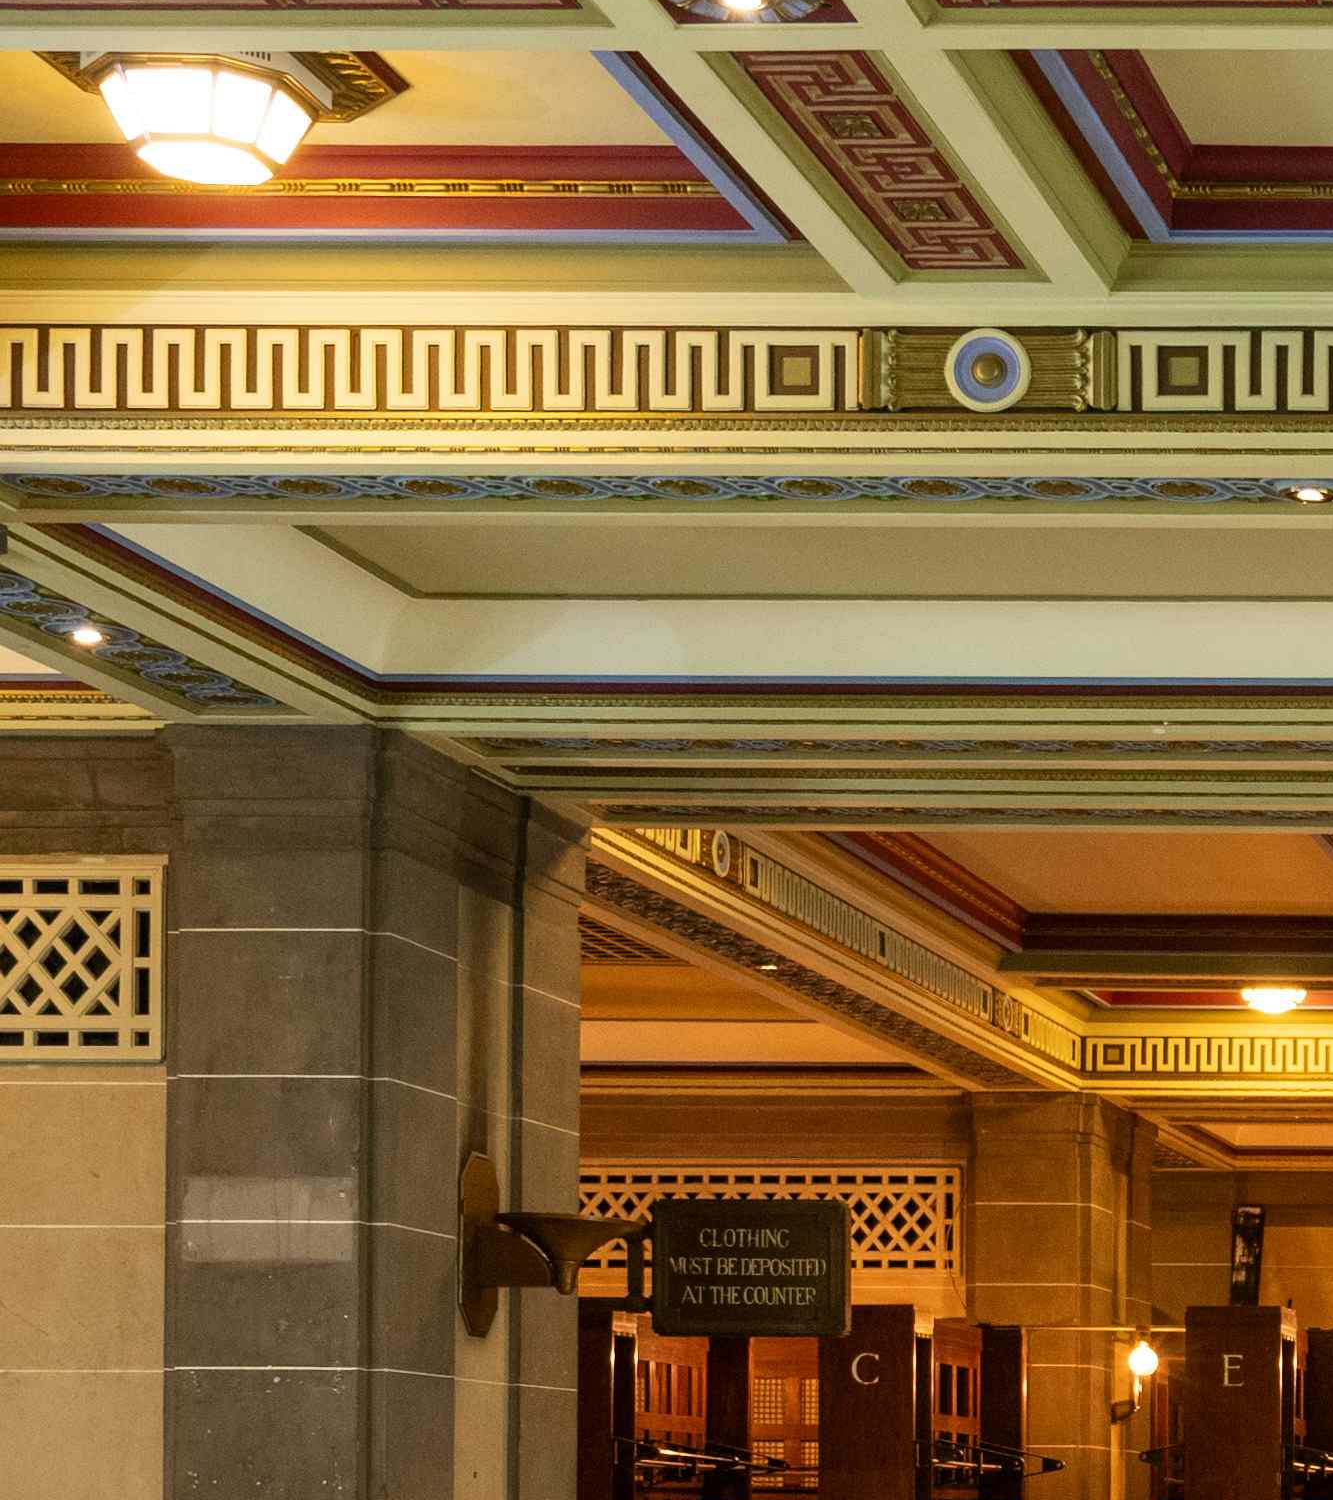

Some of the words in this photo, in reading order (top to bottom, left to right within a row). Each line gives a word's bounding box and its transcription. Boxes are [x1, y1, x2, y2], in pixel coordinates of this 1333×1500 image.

[699, 1228, 790, 1248] CLOTHING
[669, 1257, 713, 1276] MUST
[717, 1257, 739, 1276] BE
[741, 1258, 827, 1277] DEPOSITED
[681, 1286, 706, 1305] AT
[710, 1286, 741, 1305] THE
[743, 1286, 817, 1306] COUNTER
[851, 1352, 879, 1385] C
[1223, 1354, 1244, 1387] E
